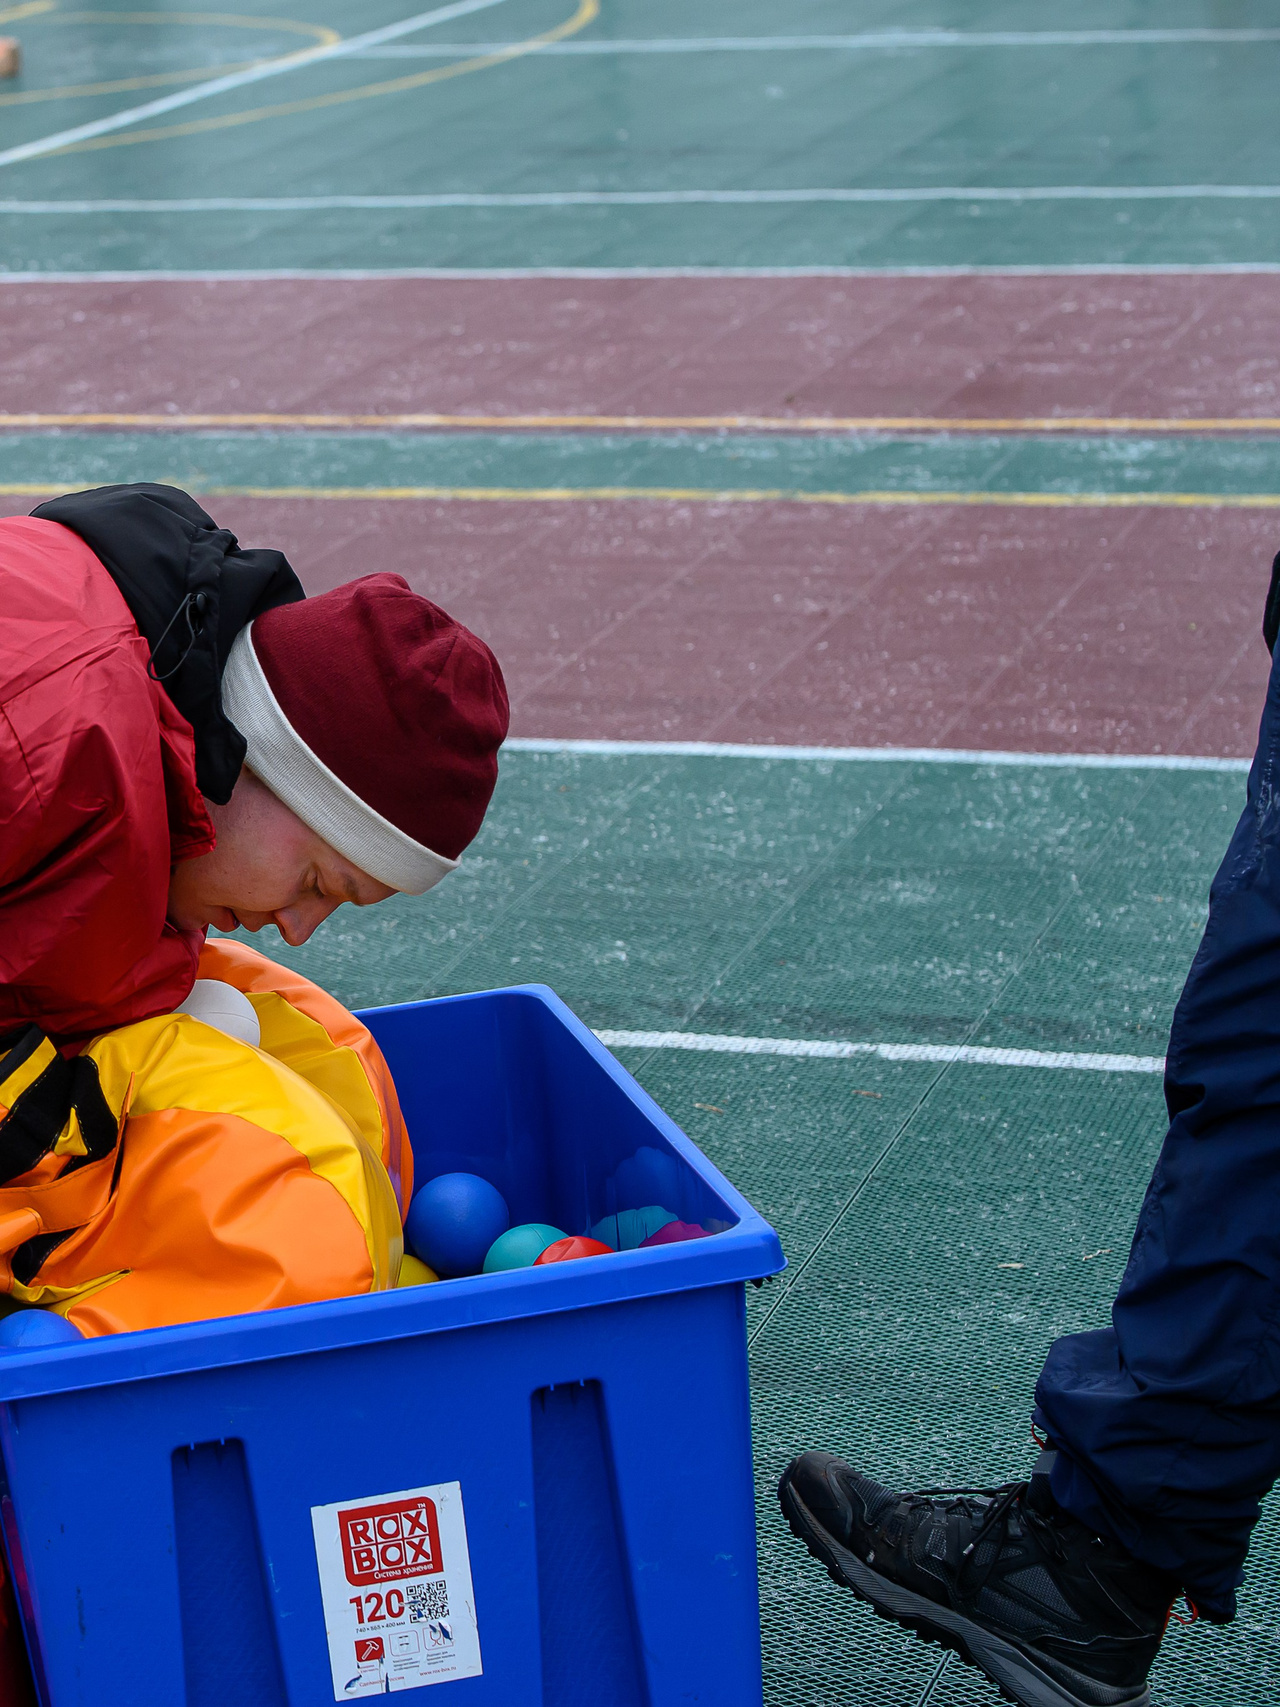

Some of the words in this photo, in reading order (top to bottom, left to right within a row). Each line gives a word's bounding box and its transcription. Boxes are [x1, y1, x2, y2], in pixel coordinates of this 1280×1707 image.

[349, 1510, 427, 1545] ROX
[353, 1537, 430, 1573] BOX
[374, 1569, 401, 1579] Система
[403, 1564, 433, 1575] хранения
[349, 1588, 405, 1624] 120
